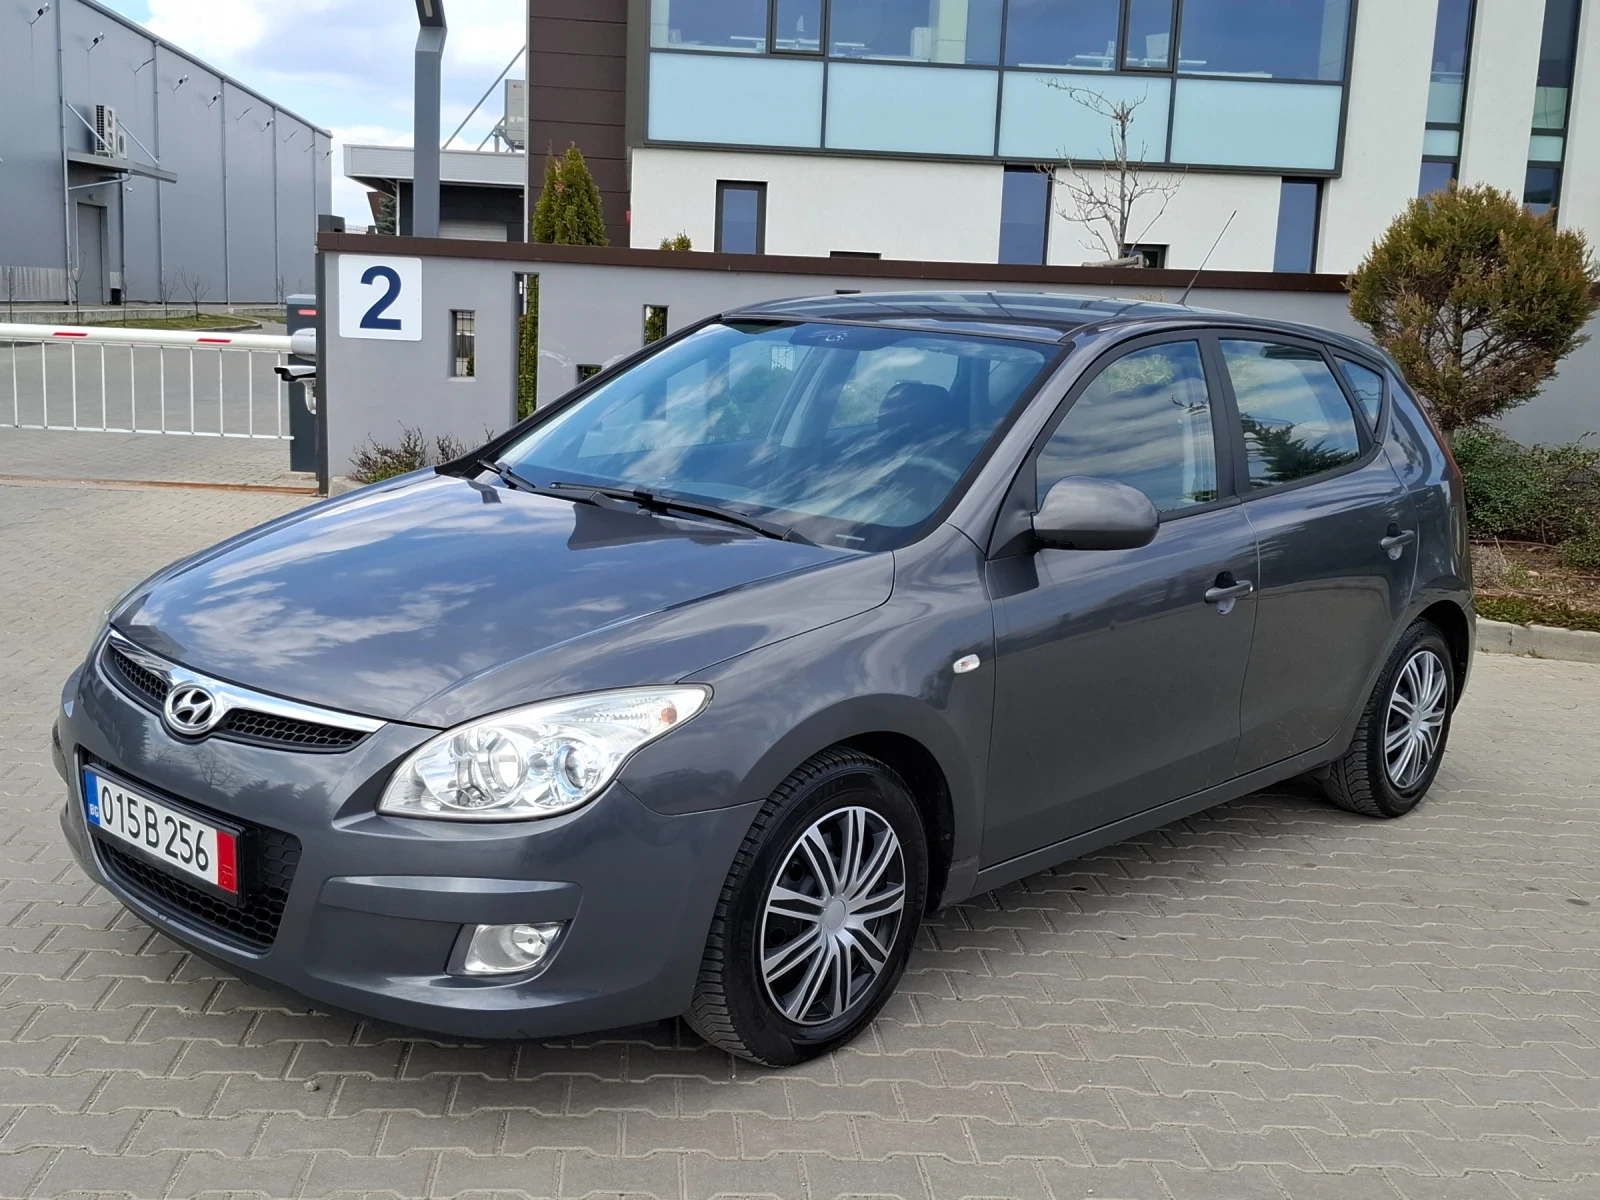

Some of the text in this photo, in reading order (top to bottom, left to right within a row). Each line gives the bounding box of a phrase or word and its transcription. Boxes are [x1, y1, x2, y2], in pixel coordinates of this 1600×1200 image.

[359, 265, 402, 331] 2
[89, 803, 99, 818] BG
[101, 785, 210, 872] 015B256
